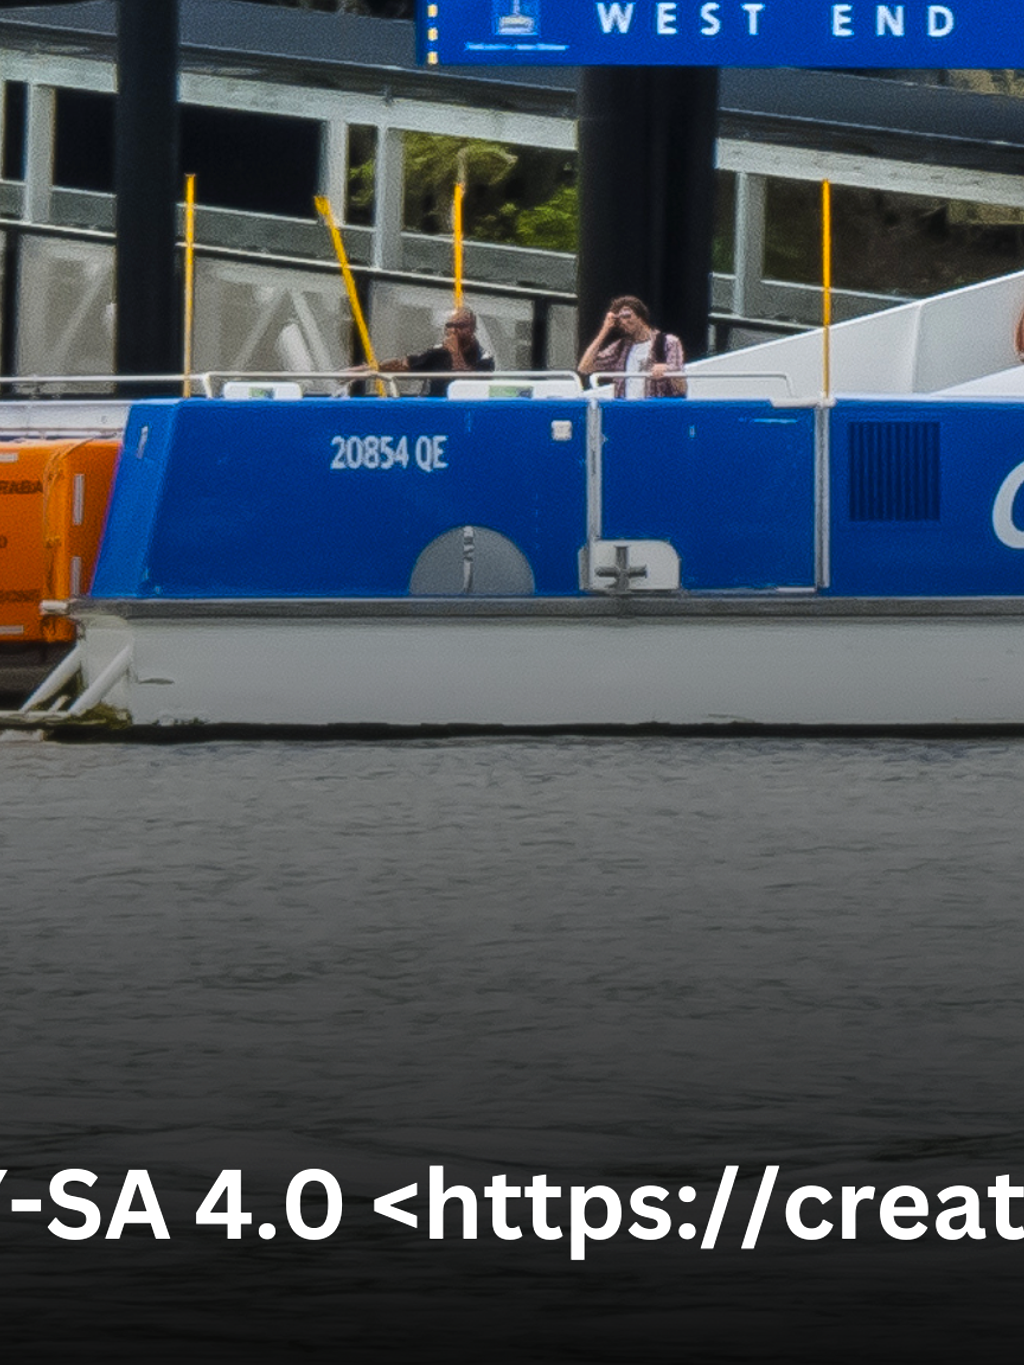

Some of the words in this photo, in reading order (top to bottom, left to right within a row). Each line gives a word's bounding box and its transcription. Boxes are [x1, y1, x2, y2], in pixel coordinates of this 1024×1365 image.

[596, 1, 766, 36] WEST
[832, 4, 955, 38] END
[330, 435, 409, 469] 20854
[415, 435, 448, 472] QE
